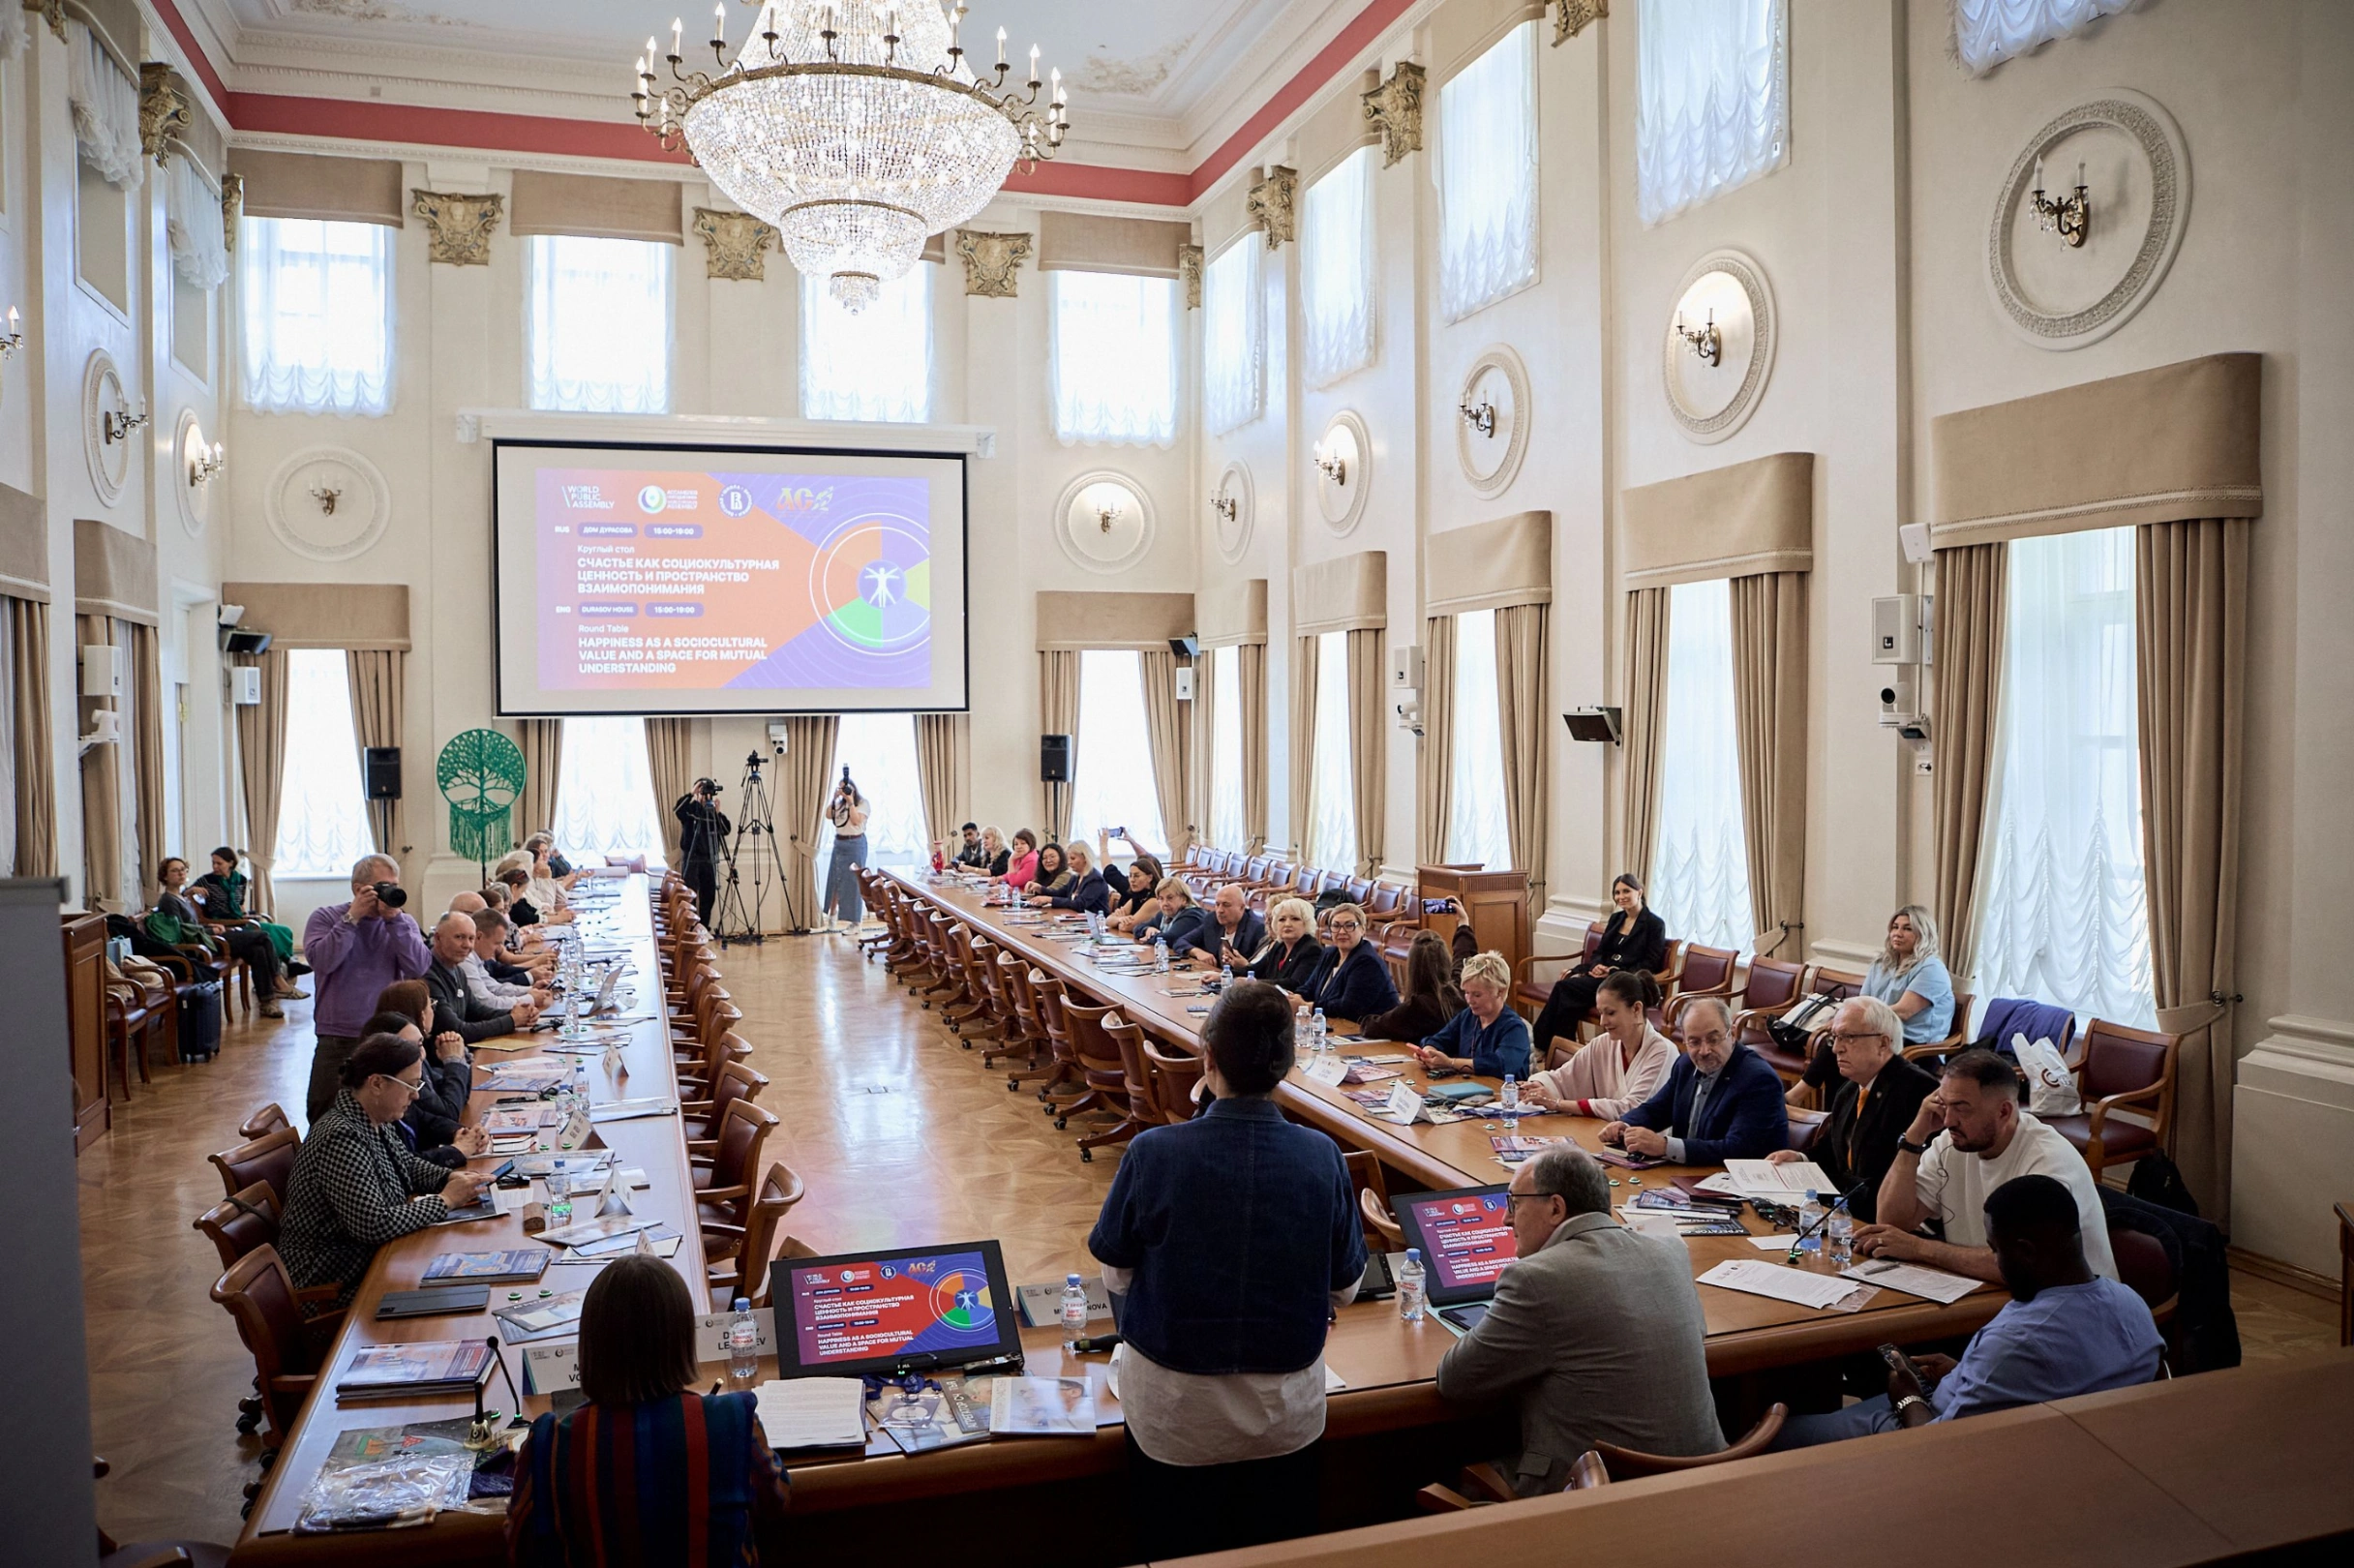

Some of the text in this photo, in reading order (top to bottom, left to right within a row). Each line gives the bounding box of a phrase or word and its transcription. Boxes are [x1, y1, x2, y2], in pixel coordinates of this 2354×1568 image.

[572, 500, 615, 509] ASSEMBLY
[577, 544, 614, 555] Круглый
[577, 558, 779, 570] СЧАСТЬЕ КАК СОЦИОКУЛЬТУРНАЯ
[577, 570, 749, 582] ЦЕННОСТЬ И ПРОСТРАНСТВО
[578, 583, 705, 594] ВЗАИМОПОНИМАНИЯ
[579, 624, 629, 633] Round Table
[579, 637, 768, 648] HAPPINESS AS A SOCIOCULTURAL
[579, 649, 768, 660] VALUE AND A SPACE FOR MUTUAL
[579, 663, 677, 674] UNDERSTANDING
[820, 1346, 868, 1355] UNDERSTANDING
